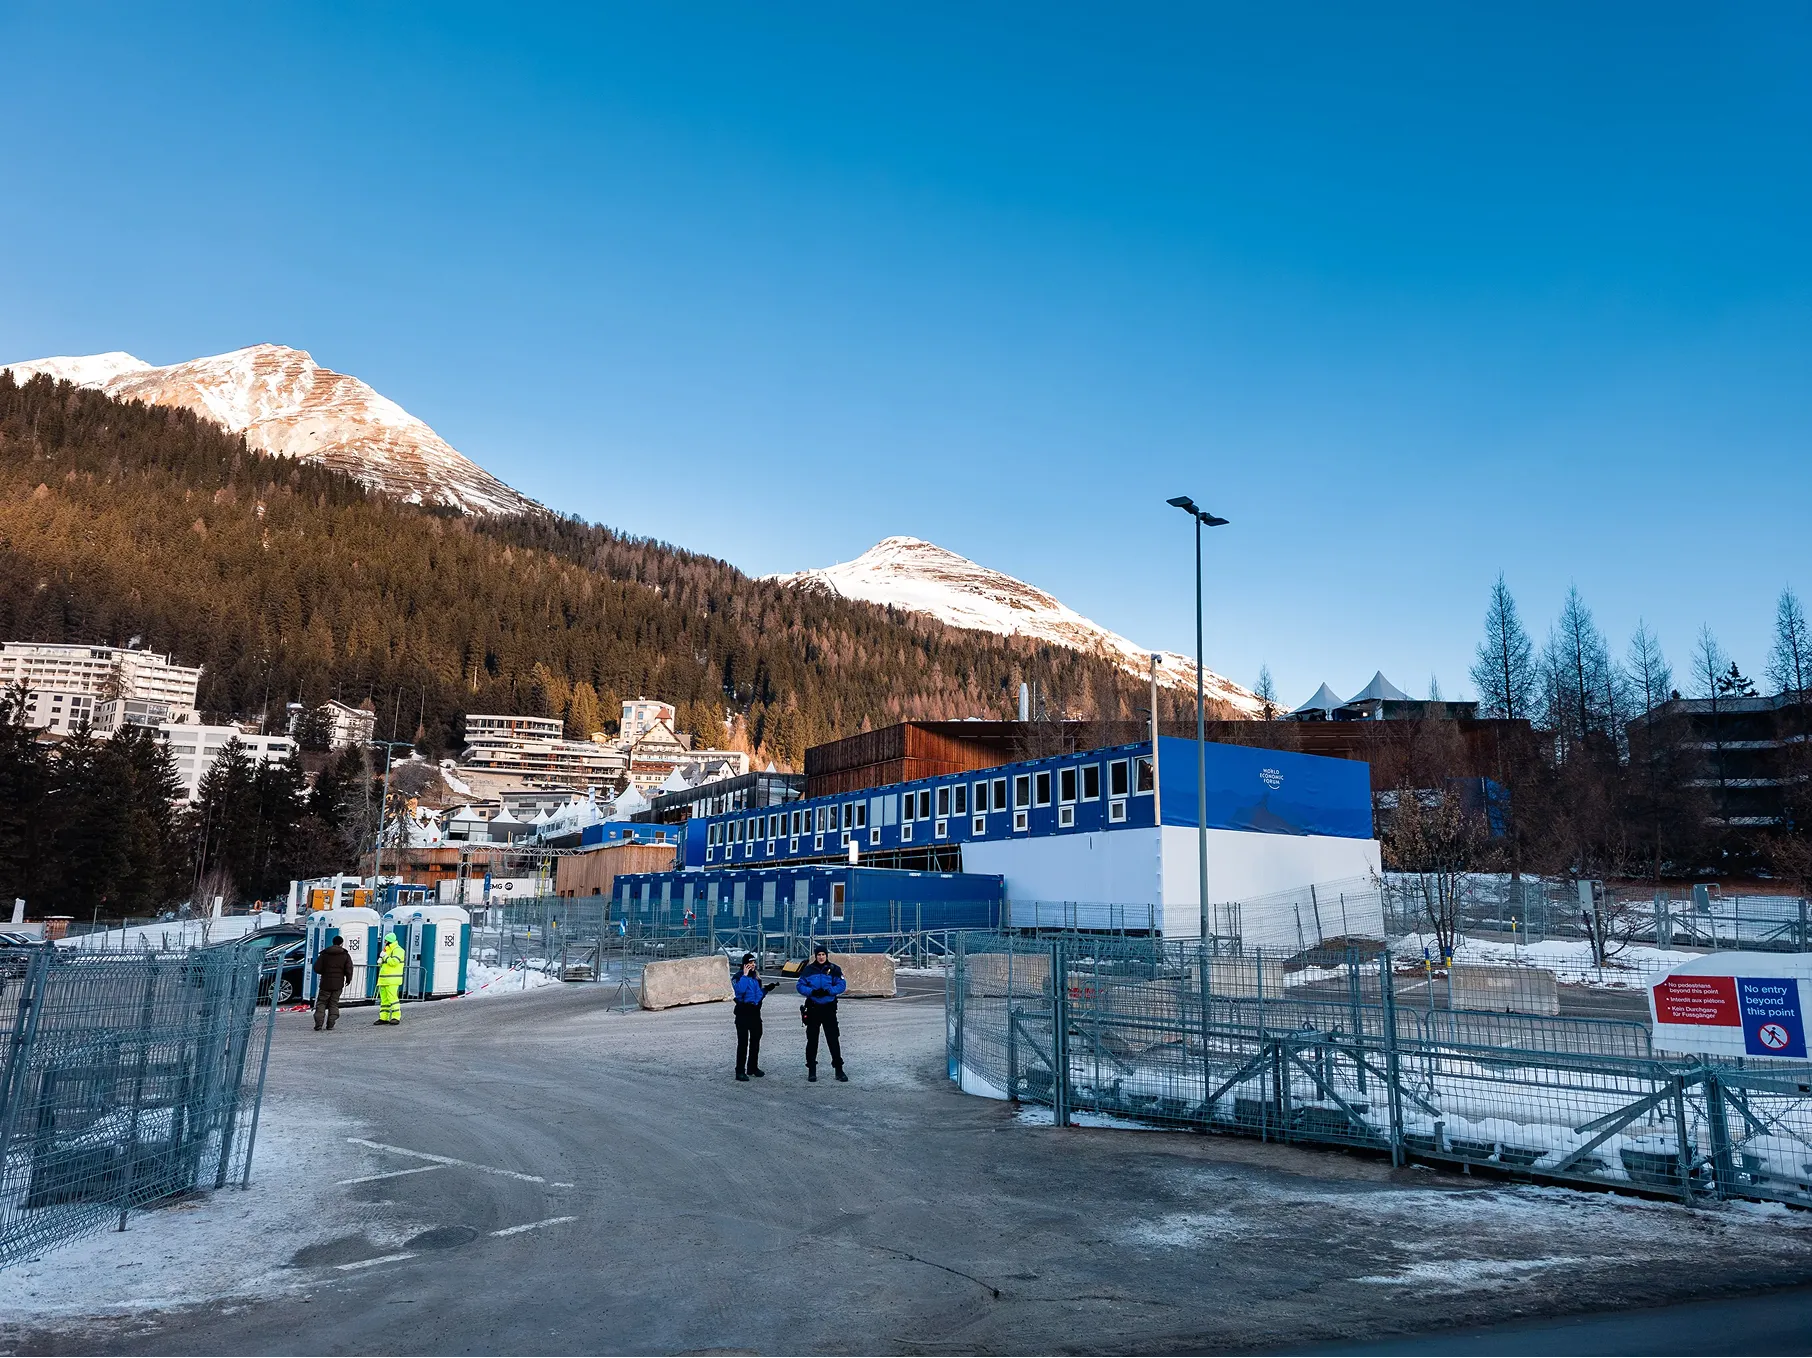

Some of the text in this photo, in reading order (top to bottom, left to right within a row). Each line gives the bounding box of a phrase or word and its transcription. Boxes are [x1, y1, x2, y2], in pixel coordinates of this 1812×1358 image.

[1744, 984, 1787, 995] No entry
[1745, 996, 1784, 1006] beyond
[1747, 1006, 1795, 1017] this point
